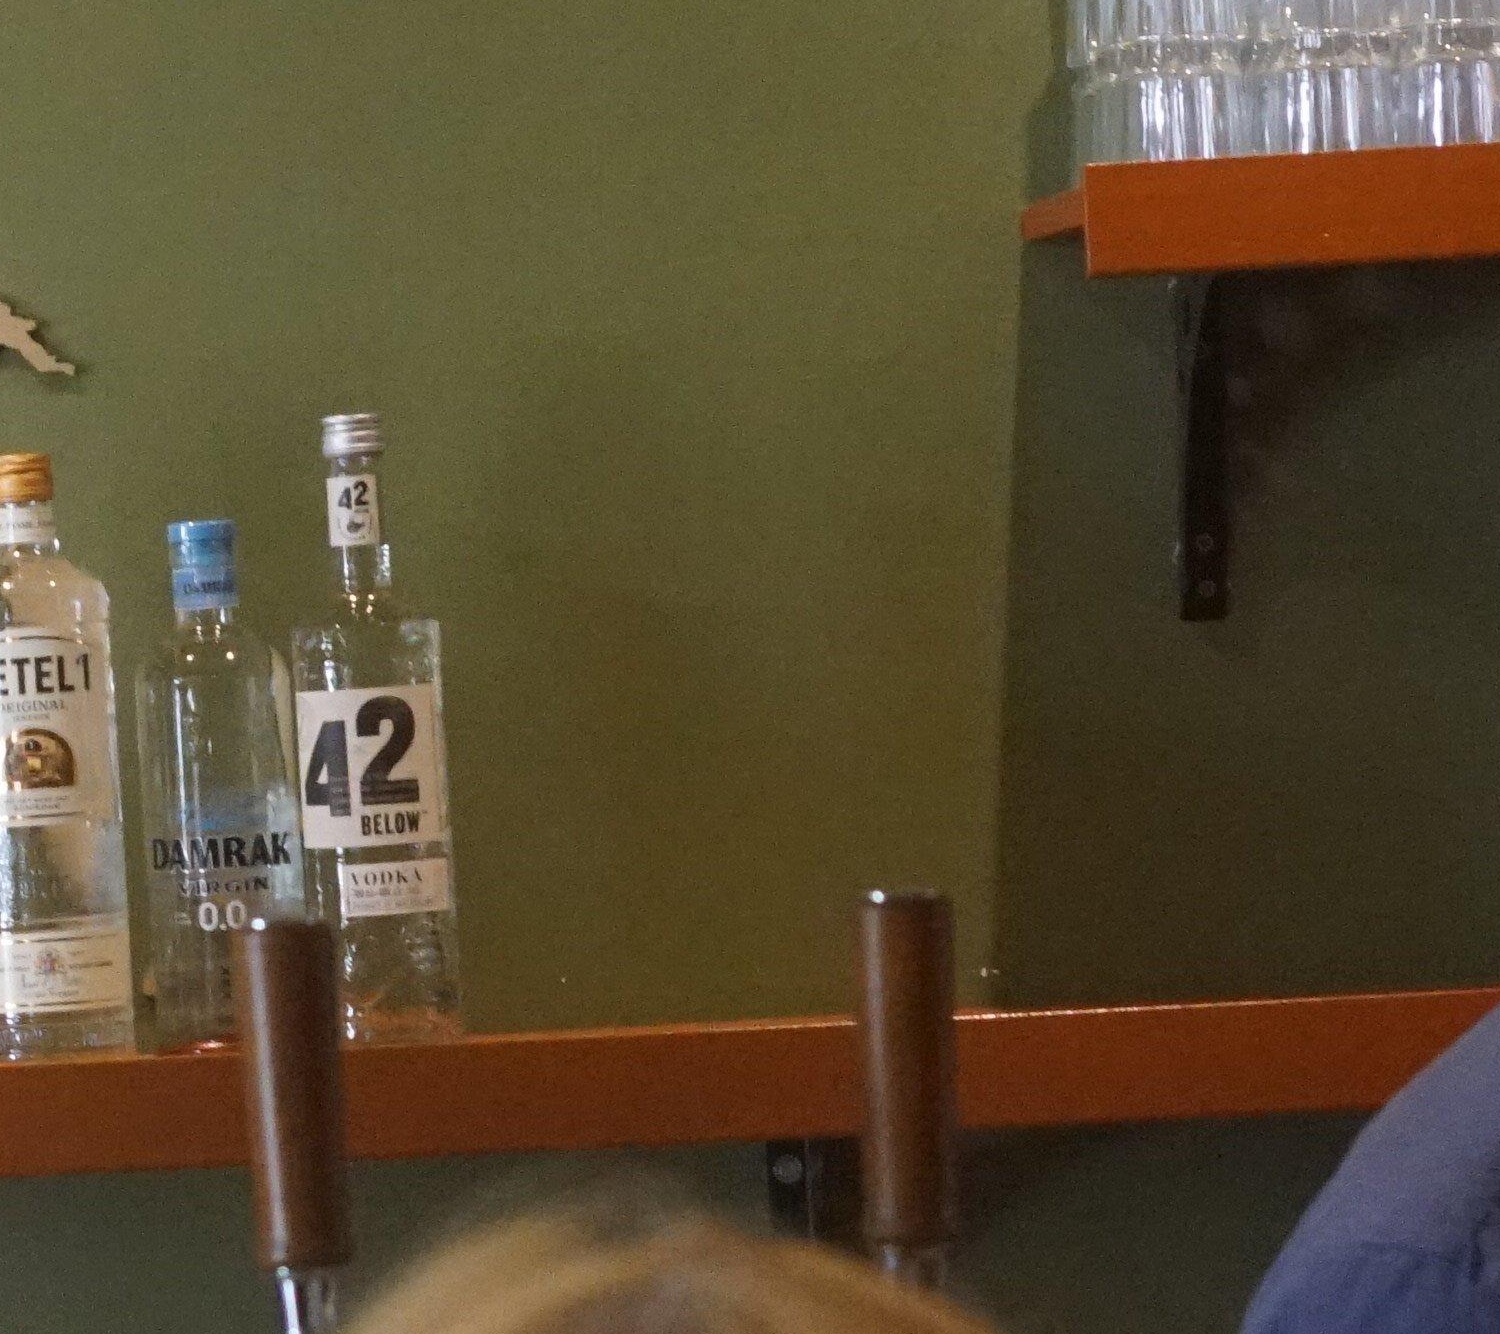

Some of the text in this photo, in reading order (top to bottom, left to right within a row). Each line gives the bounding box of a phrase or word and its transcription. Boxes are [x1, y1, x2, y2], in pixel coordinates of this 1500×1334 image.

[337, 480, 370, 510] 42
[305, 695, 421, 818] 42
[360, 810, 420, 837] BELOW
[152, 830, 293, 871] DAMRAK
[351, 867, 424, 886] VODKA
[198, 900, 248, 932] 0.0
